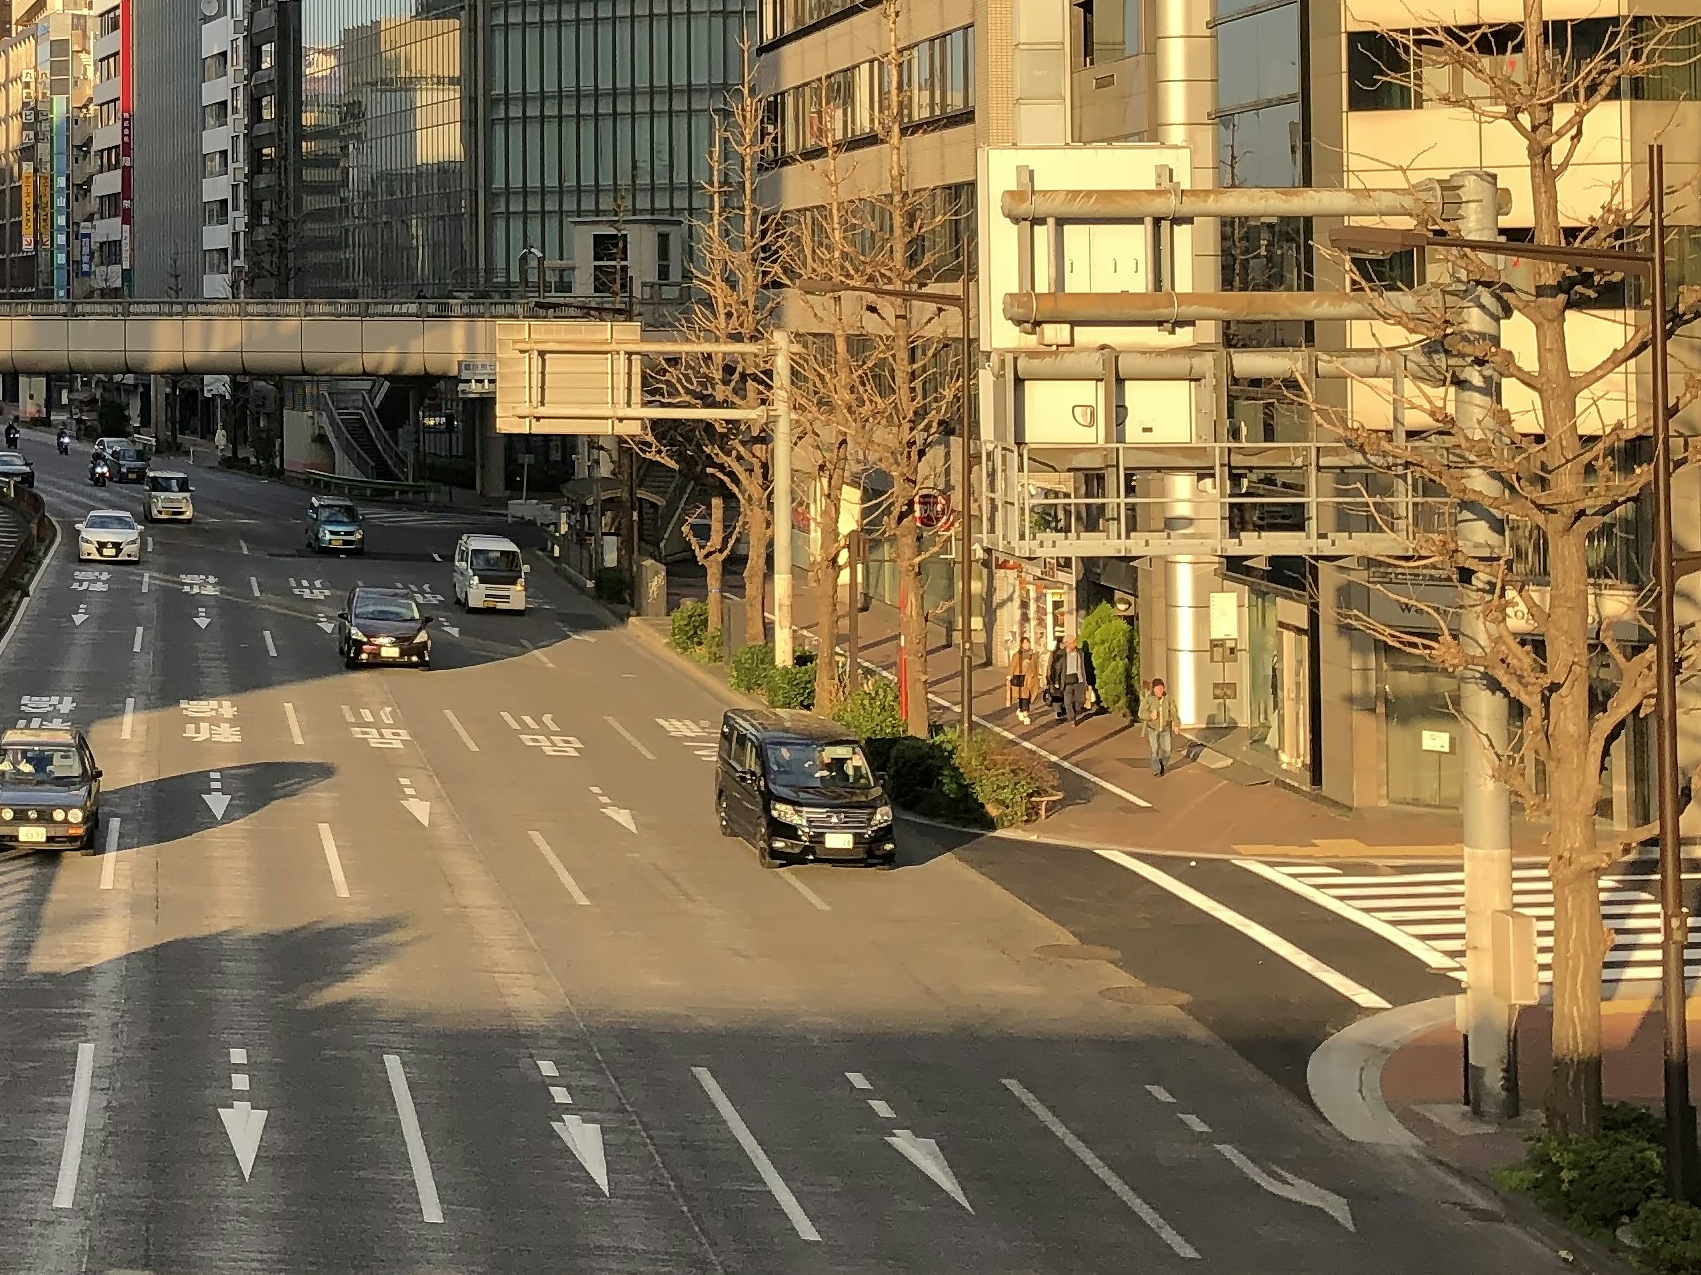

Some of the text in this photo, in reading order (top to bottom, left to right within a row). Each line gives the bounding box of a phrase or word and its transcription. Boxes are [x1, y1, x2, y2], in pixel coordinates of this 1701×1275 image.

[179, 699, 242, 743] 新橋
[340, 704, 413, 749] 品川
[499, 711, 585, 757] 品川
